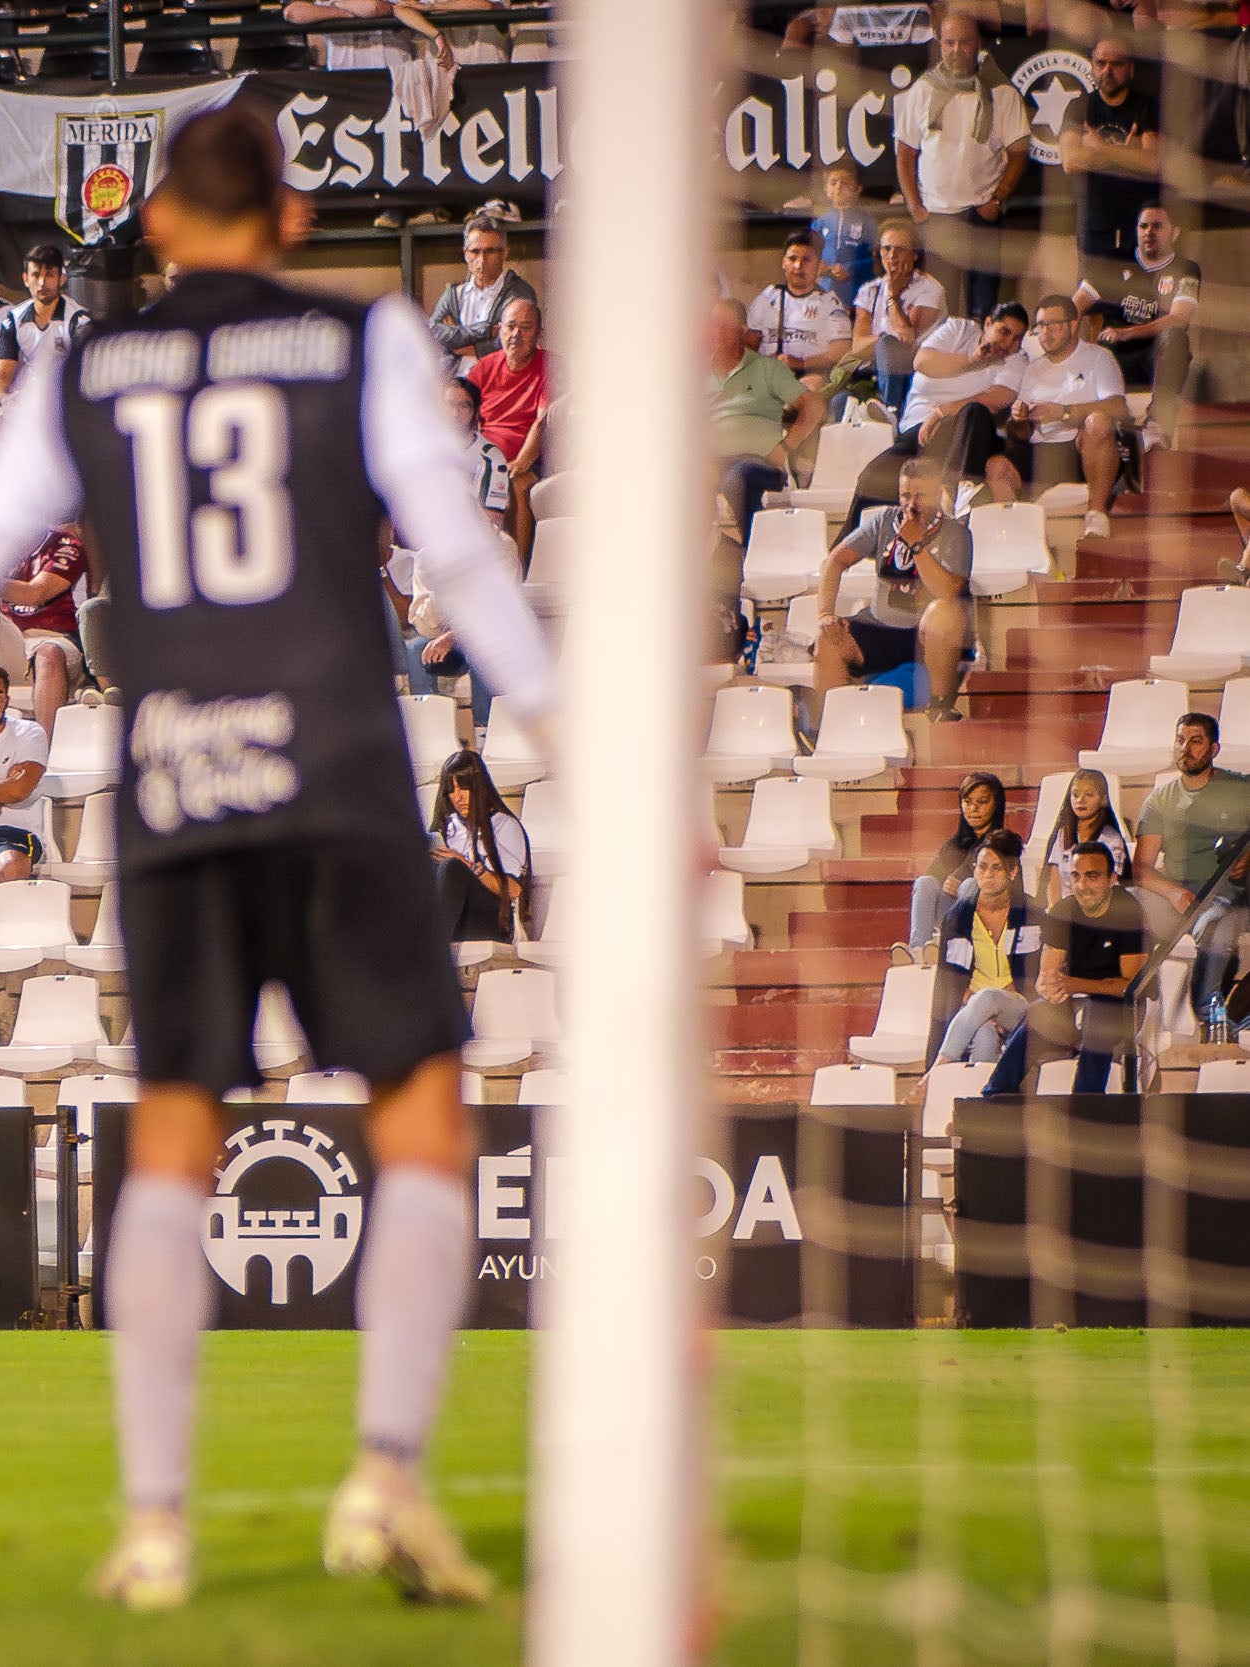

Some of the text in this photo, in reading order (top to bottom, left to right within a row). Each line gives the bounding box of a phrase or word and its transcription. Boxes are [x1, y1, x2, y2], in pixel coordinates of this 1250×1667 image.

[68, 122, 153, 143] MERIDA
[276, 87, 565, 192] Estrell
[114, 383, 296, 609] 13
